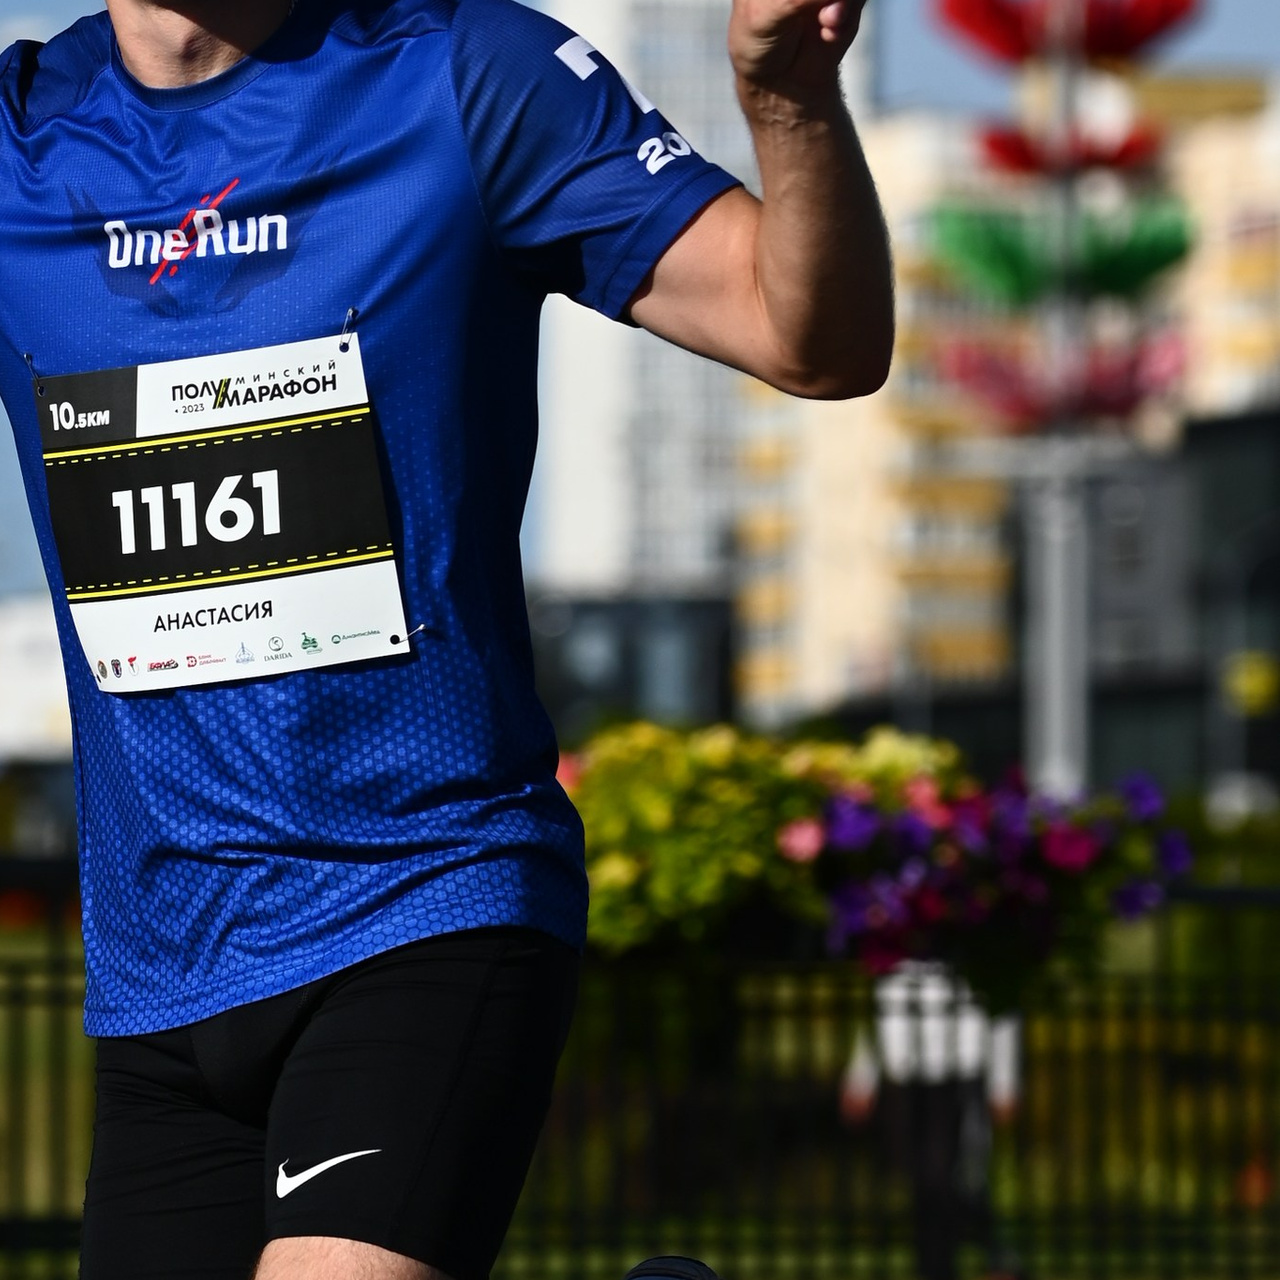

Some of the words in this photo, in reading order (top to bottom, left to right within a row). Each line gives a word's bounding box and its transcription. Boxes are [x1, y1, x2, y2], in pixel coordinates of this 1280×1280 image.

[235, 359, 337, 386] МИНСКИЙ
[181, 403, 205, 414] 2023
[111, 469, 282, 555] 11161
[153, 600, 274, 633] АНАСТАСИЯ
[264, 652, 293, 662] DARIDA
